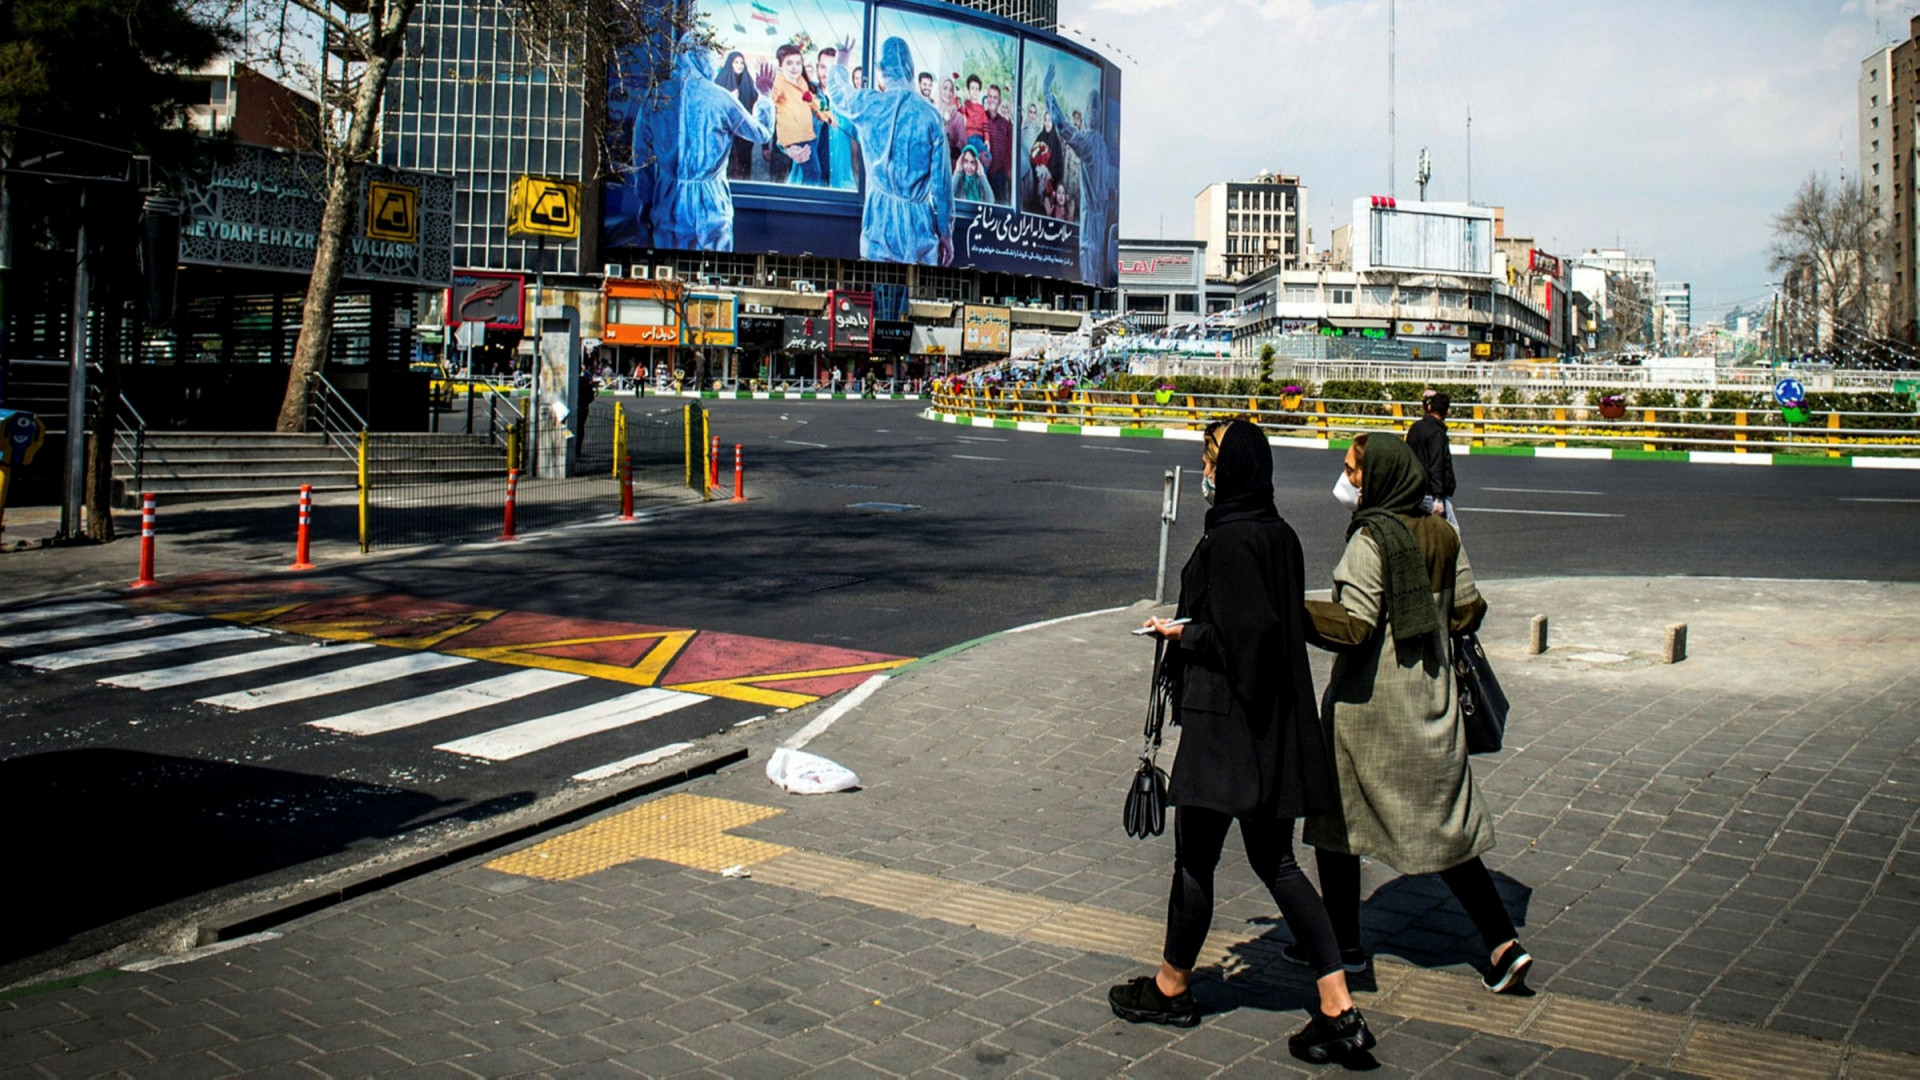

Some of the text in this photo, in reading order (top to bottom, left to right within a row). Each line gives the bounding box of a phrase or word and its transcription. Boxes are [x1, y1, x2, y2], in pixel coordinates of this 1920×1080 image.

[966, 205, 998, 258] رسانیم
[996, 213, 1012, 241] می
[1008, 215, 1033, 247] ایران
[1044, 222, 1073, 242] سلامت
[835, 312, 869, 329] بامبو
